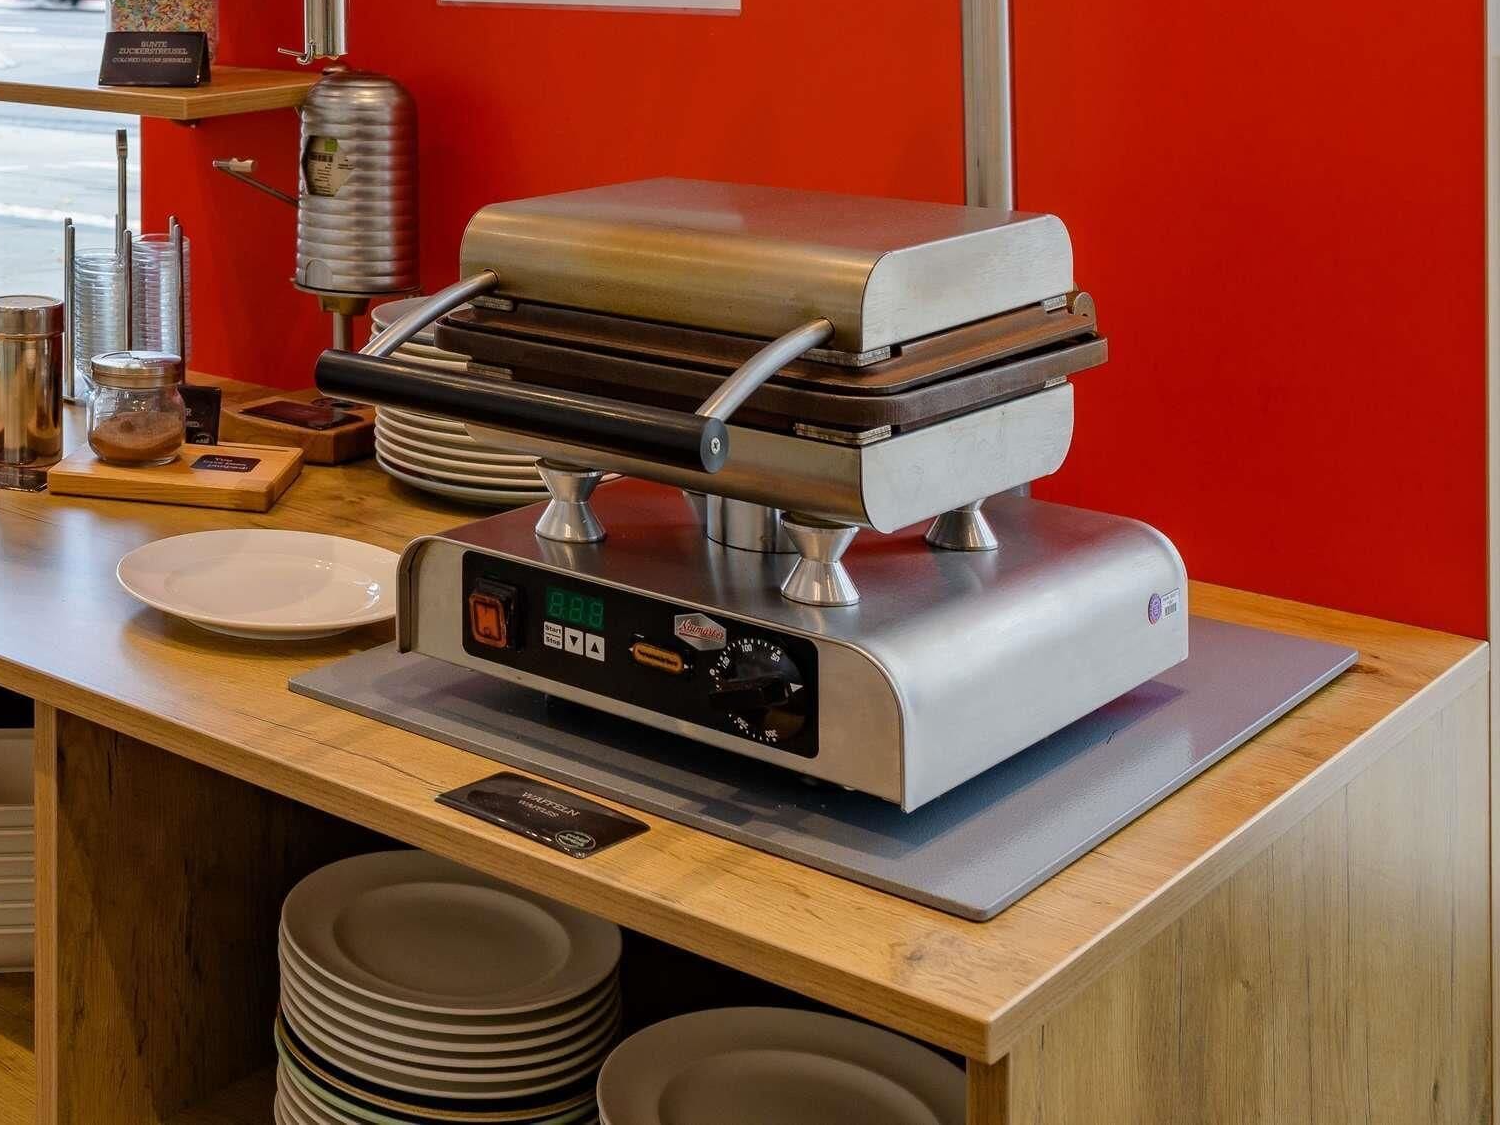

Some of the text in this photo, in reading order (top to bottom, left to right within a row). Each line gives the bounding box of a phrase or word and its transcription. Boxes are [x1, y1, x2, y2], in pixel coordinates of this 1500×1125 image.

[545, 624, 561, 634] Start
[546, 636, 561, 646] Stop
[741, 643, 753, 652] 100
